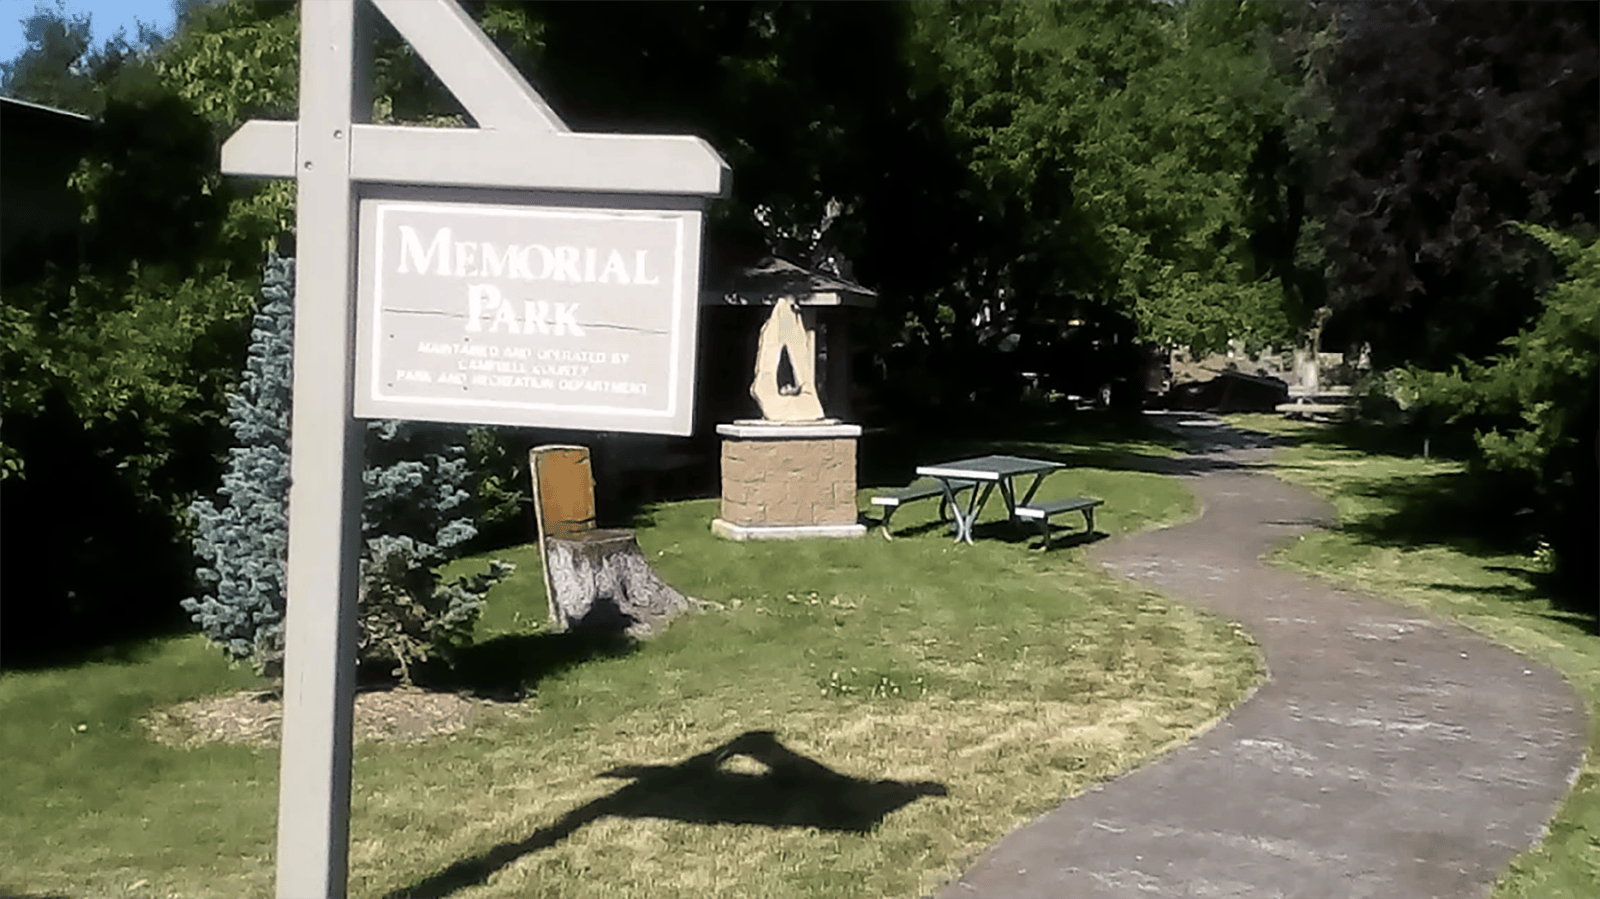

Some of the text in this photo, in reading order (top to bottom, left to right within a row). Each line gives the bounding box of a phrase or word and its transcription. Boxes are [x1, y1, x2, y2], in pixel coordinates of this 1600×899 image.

[397, 225, 659, 285] MEMORIAL
[465, 283, 586, 337] PARK
[503, 346, 532, 359] AND
[611, 352, 630, 364] BY
[436, 371, 467, 384] AND
